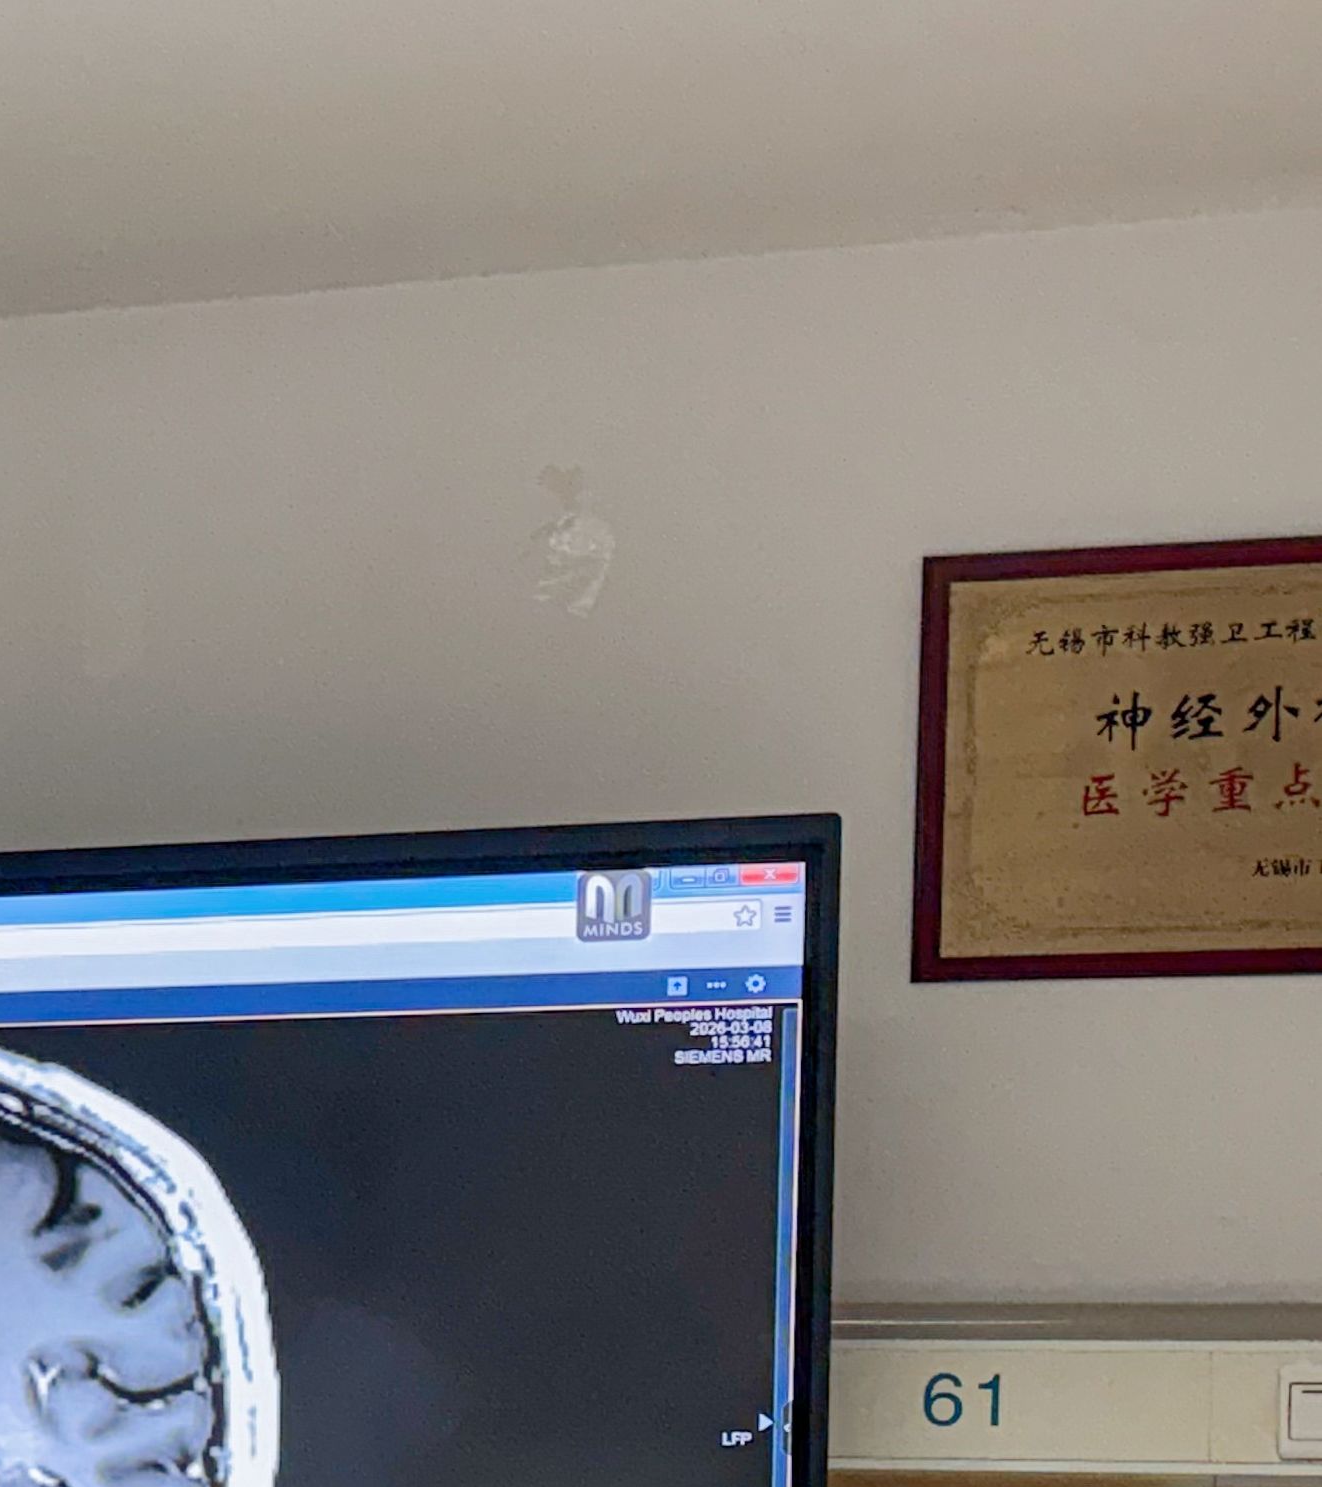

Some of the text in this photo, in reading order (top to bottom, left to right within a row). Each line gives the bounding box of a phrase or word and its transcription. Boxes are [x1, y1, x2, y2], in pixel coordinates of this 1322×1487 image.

[1251, 857, 1322, 878] 无锡市
[583, 921, 644, 938] MINDS
[714, 1005, 773, 1023] Hospital
[674, 1048, 772, 1066] SIEMENS MR
[922, 1373, 1002, 1427] 61
[721, 1432, 752, 1447] LFP
